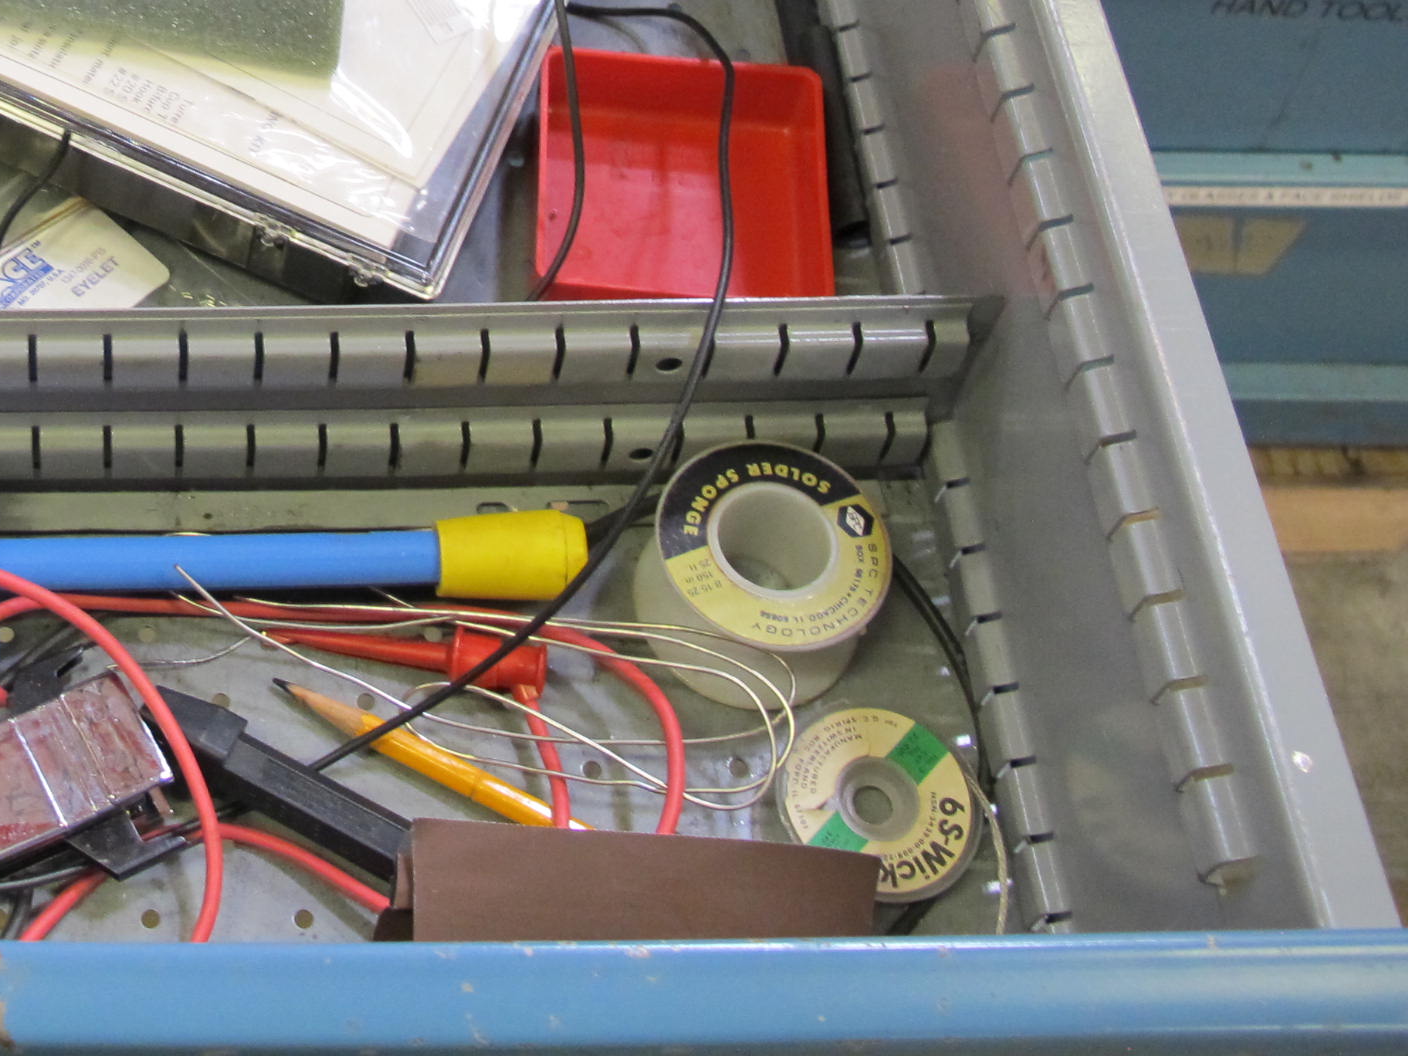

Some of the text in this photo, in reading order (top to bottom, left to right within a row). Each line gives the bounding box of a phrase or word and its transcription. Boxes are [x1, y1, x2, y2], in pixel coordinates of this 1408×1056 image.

[70, 255, 121, 298] EYELET
[683, 462, 832, 536] SOLDER SPONGE
[752, 543, 879, 637] SPC TECHNOLOGY
